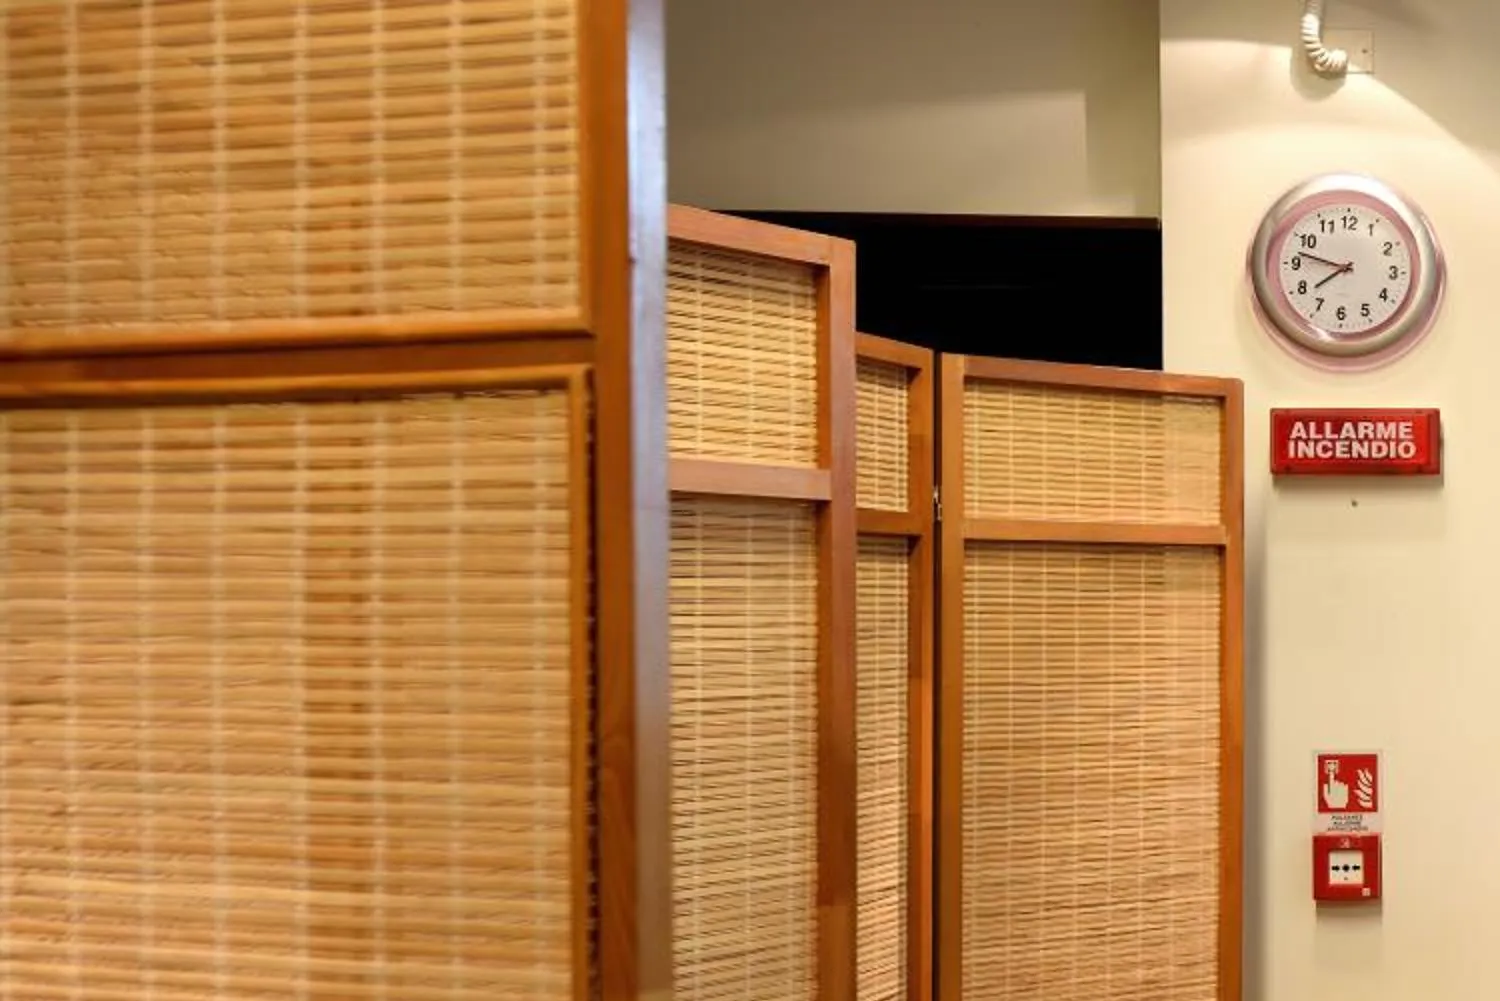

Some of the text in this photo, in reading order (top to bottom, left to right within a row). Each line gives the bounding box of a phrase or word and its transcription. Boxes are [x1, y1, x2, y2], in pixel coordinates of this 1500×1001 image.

[1319, 220, 1335, 233] 11
[1341, 216, 1358, 231] 12
[1368, 223, 1375, 236] 1
[1300, 234, 1316, 249] 10
[1383, 242, 1393, 256] 2
[1291, 256, 1301, 270] 9
[1389, 266, 1398, 280] 3
[1298, 281, 1307, 295] 8
[1379, 288, 1388, 302] 4
[1315, 298, 1325, 311] 7
[1360, 304, 1370, 317] 5
[1336, 306, 1346, 320] 6
[1290, 421, 1414, 439] ALLARME
[1288, 440, 1417, 459] INCENDIO
